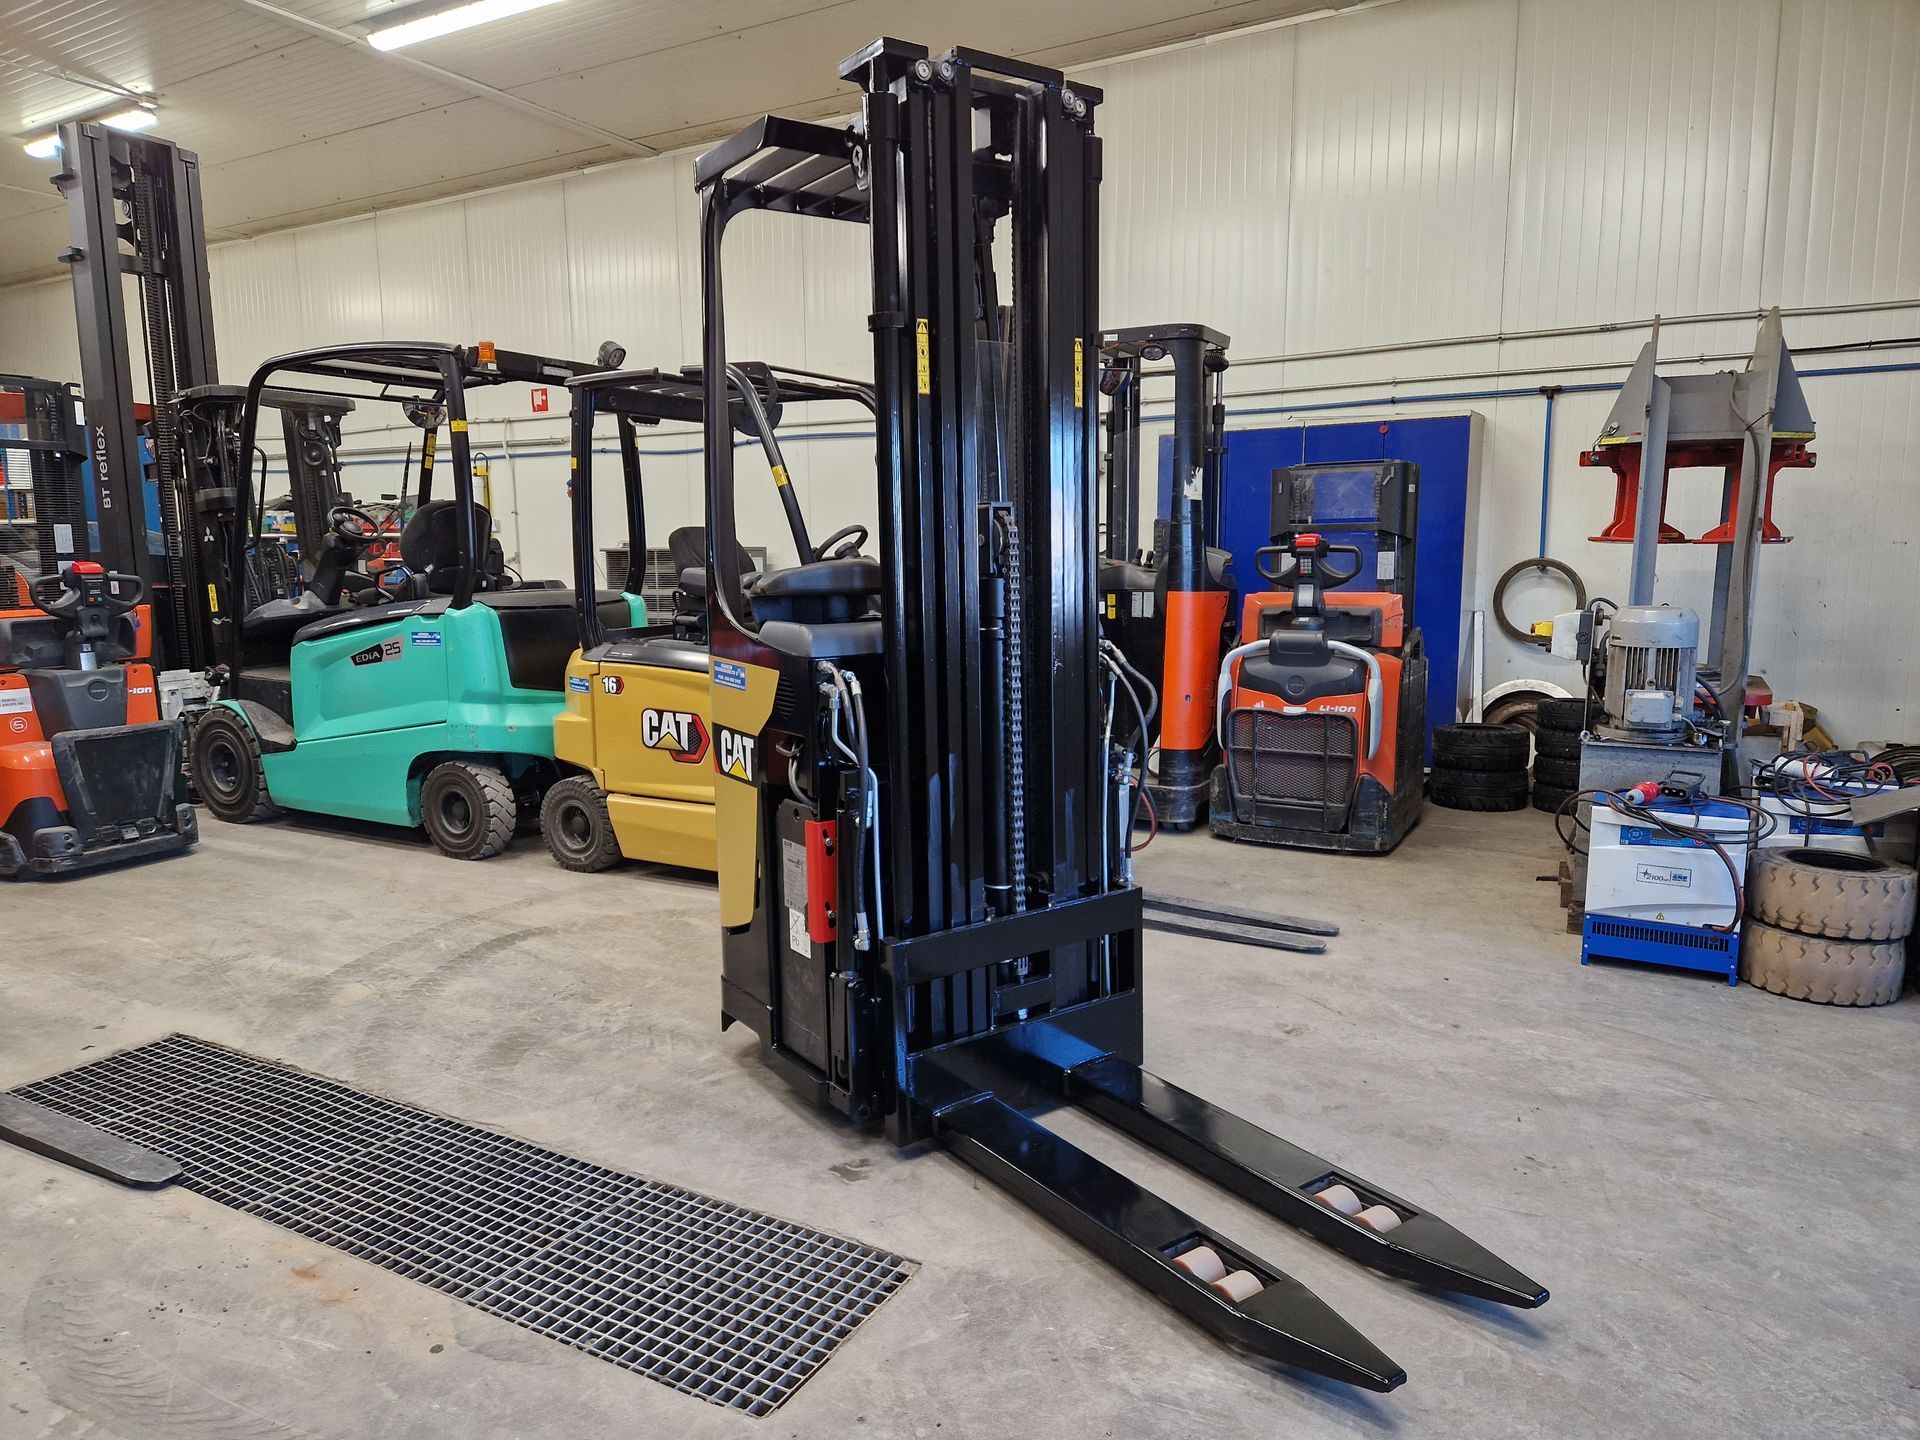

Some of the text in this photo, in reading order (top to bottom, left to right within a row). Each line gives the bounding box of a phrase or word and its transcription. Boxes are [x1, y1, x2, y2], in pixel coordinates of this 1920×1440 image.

[96, 425, 112, 509] BT reflex
[384, 641, 401, 656] 25
[602, 676, 617, 693] 16
[642, 709, 692, 751] CAT
[720, 729, 754, 782] CAT
